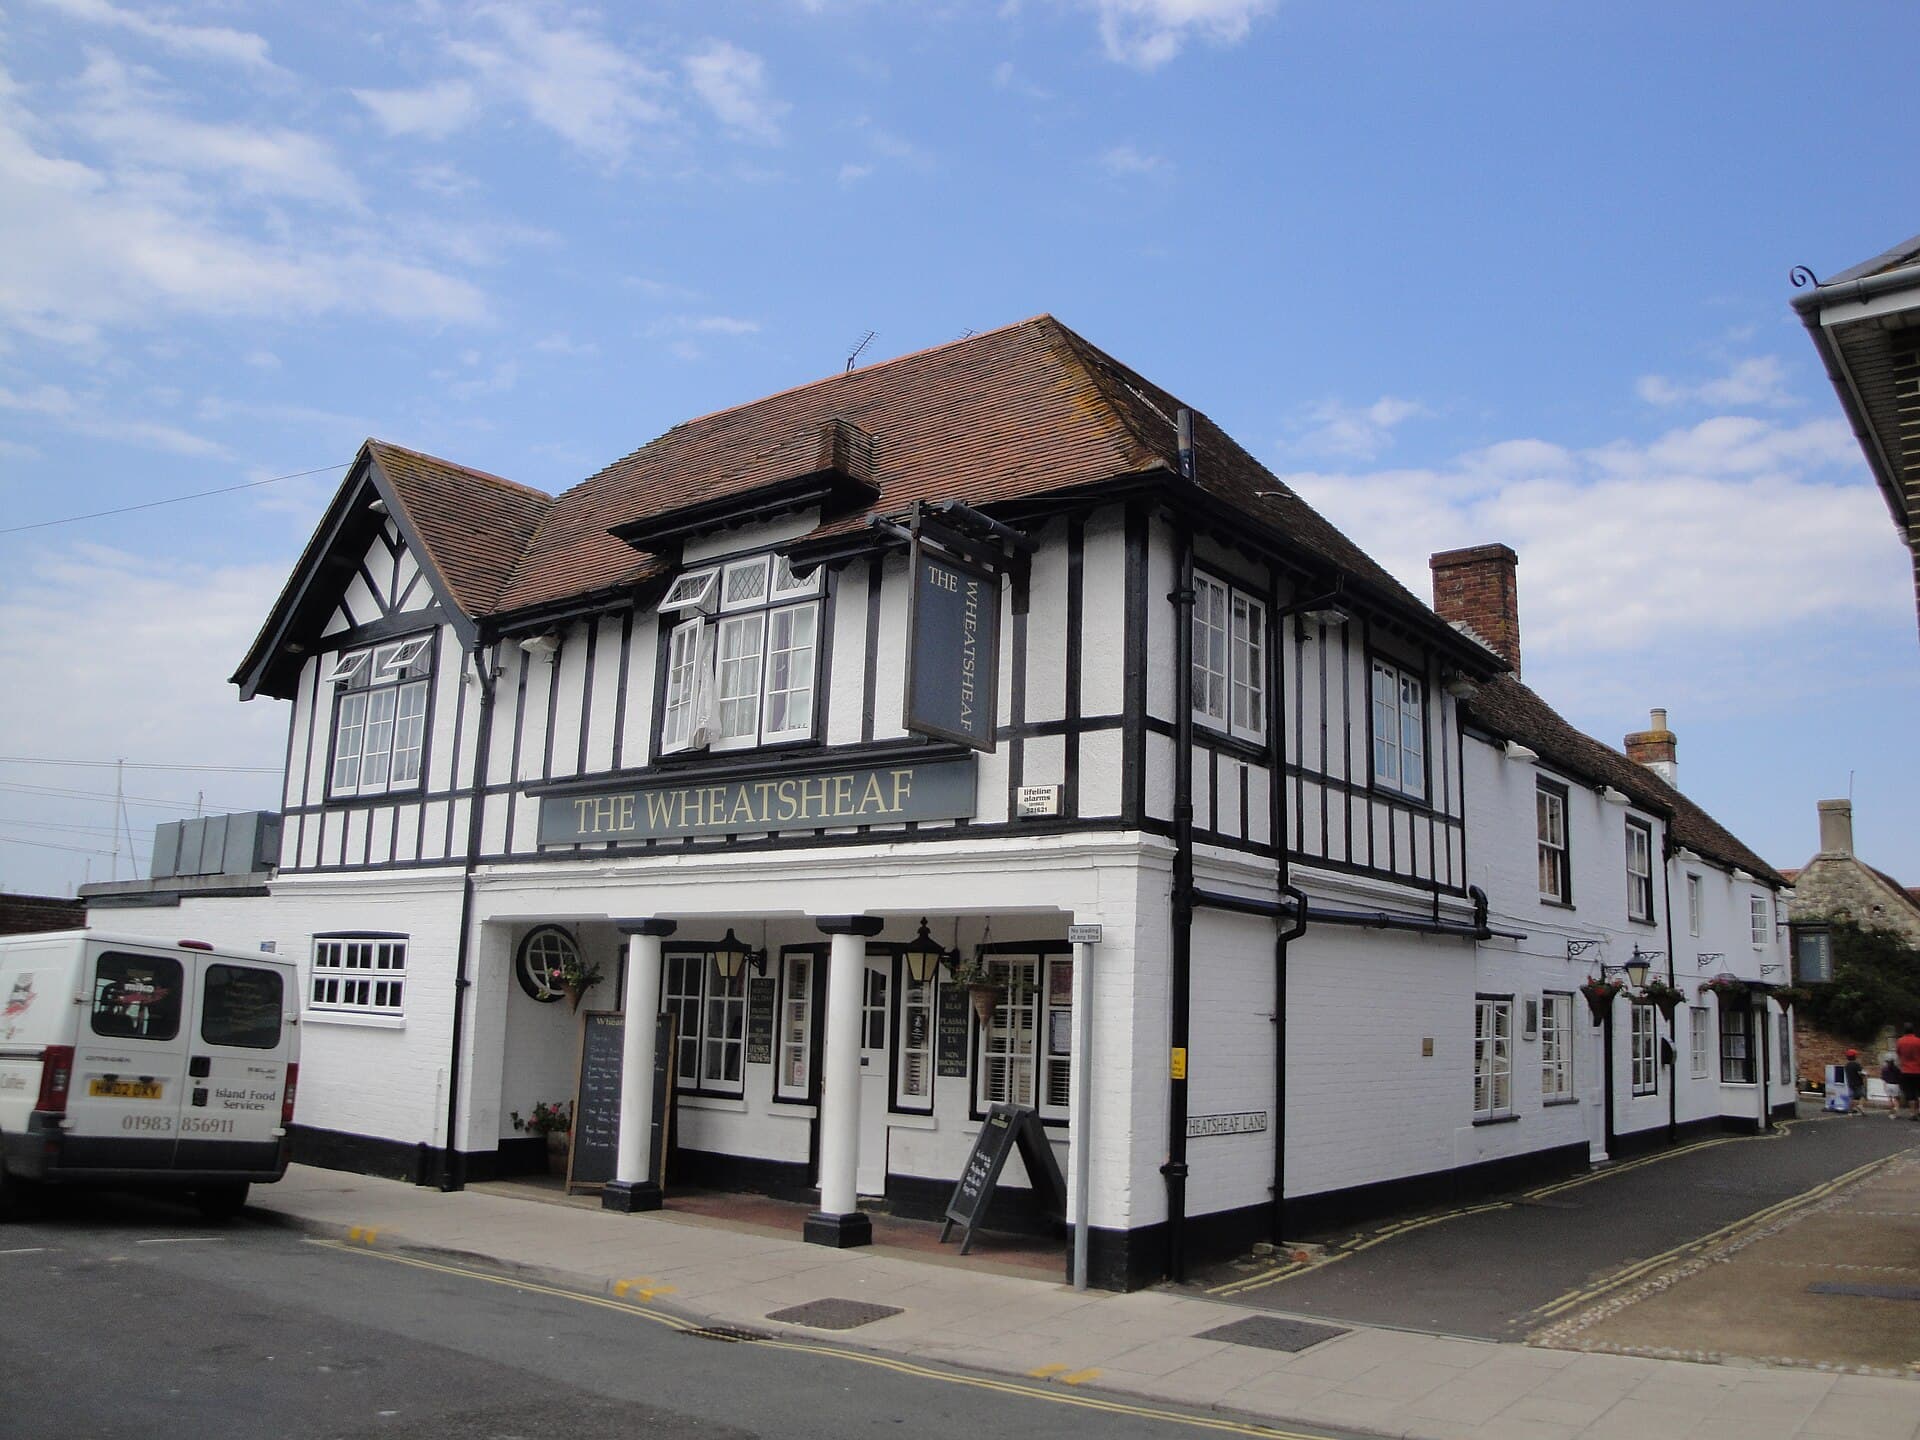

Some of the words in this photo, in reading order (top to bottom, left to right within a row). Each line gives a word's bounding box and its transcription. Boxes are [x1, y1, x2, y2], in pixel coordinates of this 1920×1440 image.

[928, 566, 958, 593] THE
[960, 580, 979, 732] WHEATSHEAF
[574, 795, 636, 834] THE
[645, 769, 913, 830] WHEATSHEAF
[1023, 788, 1052, 796] lifeline
[250, 1090, 276, 1101] Food
[223, 1100, 265, 1111] Services
[122, 1115, 172, 1131] 01983
[181, 1118, 234, 1133] 856911
[1188, 1117, 1239, 1135] HEATSHEAF
[1243, 1115, 1265, 1130] LANE
